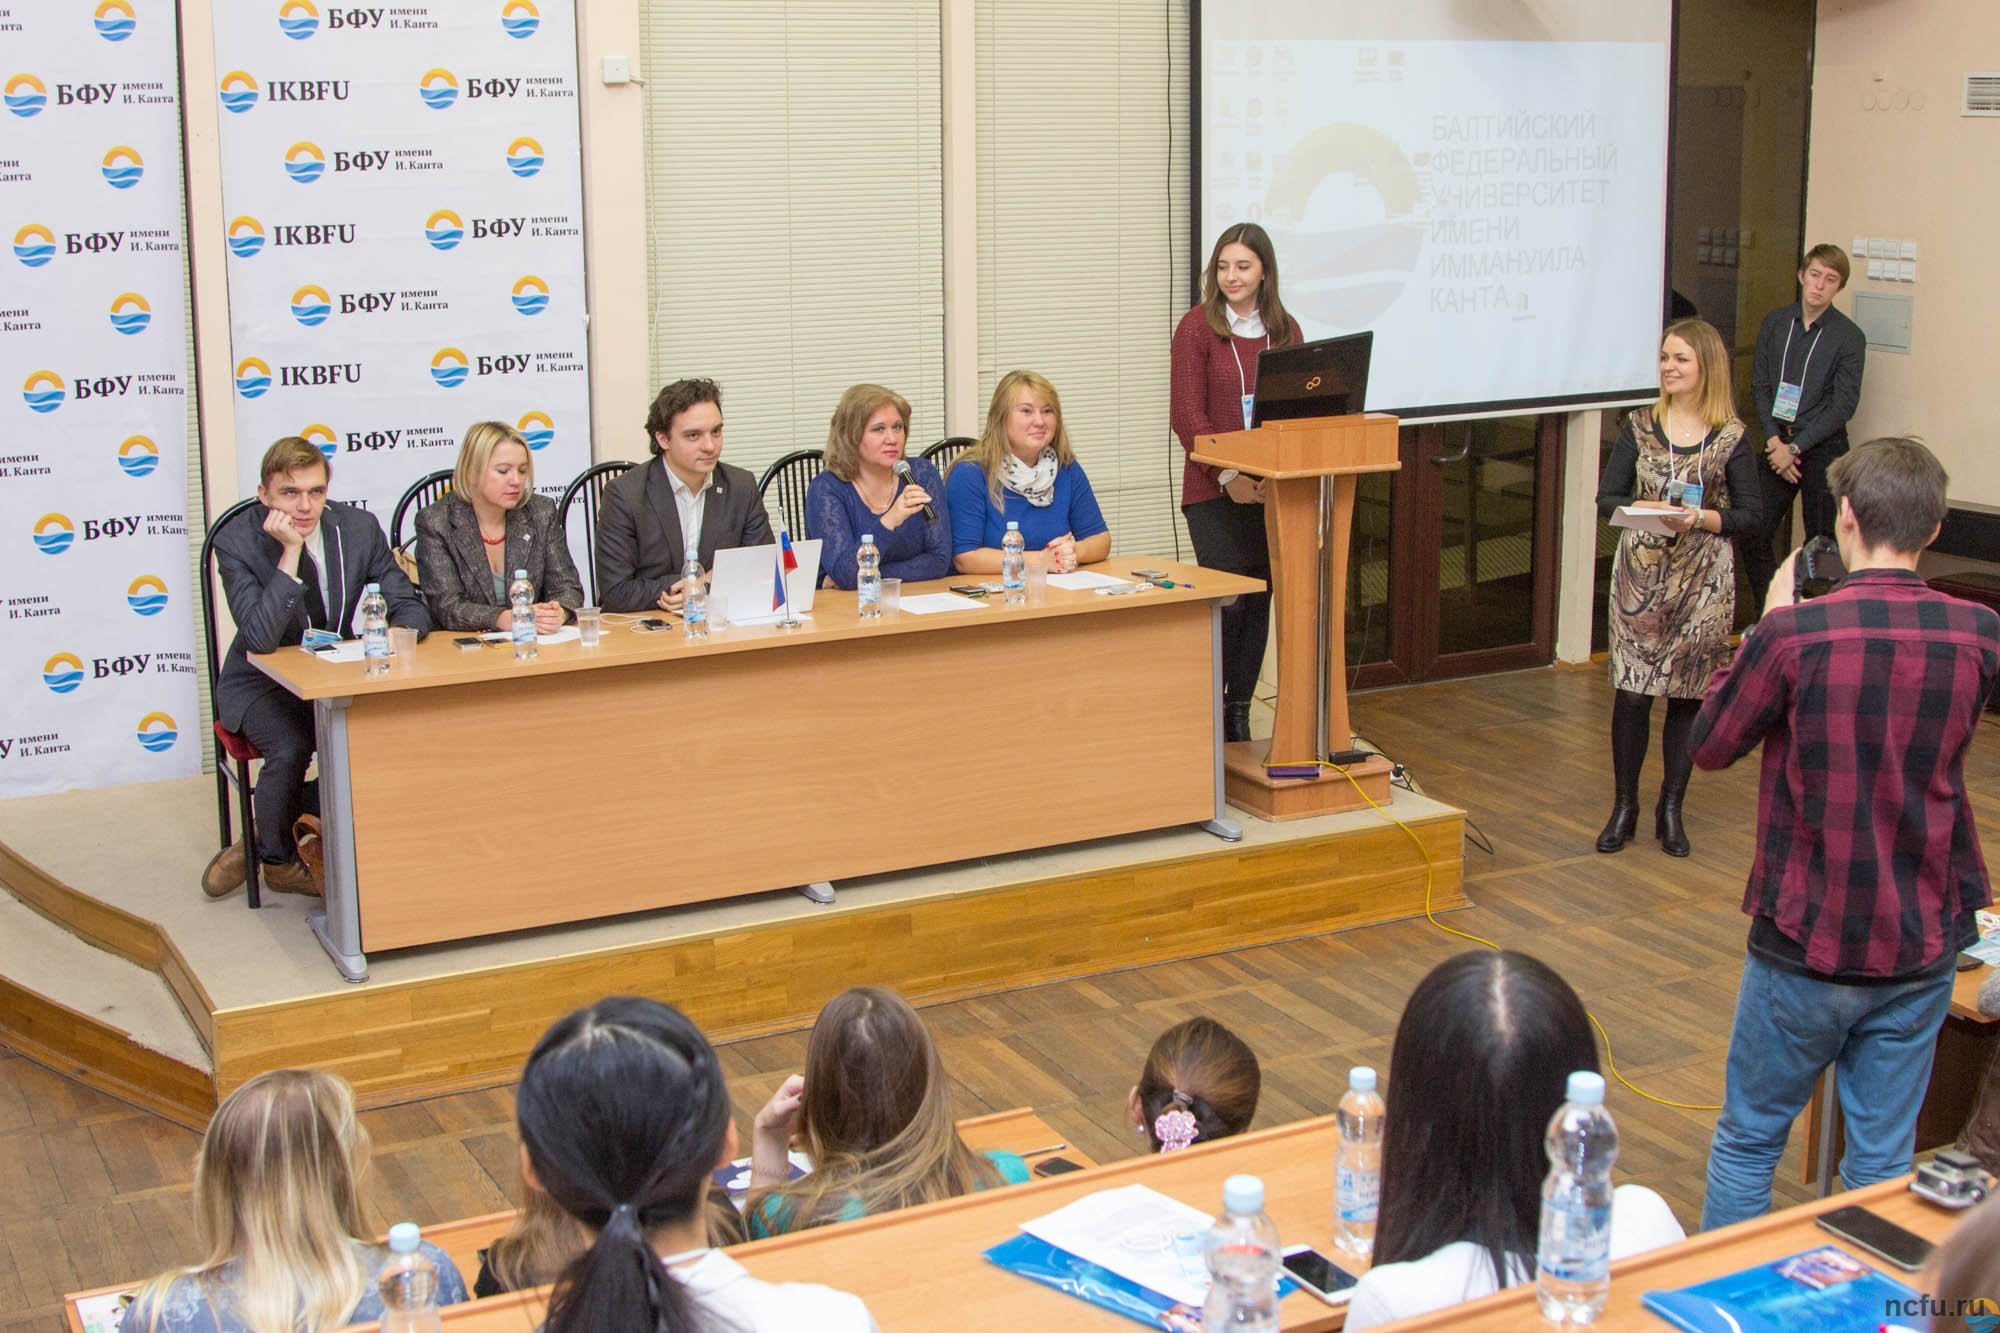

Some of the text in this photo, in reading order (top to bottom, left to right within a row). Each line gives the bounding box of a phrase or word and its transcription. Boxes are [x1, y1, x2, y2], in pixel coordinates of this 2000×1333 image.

[328, 9, 385, 29] БФУ
[390, 8, 428, 16] имени
[0, 22, 23, 31] нта
[122, 82, 163, 91] имени
[267, 81, 350, 101] IKBFU
[467, 78, 521, 98] БФУ
[526, 77, 563, 85] имени
[56, 84, 117, 105] БФУ
[1432, 106, 1596, 142] БАЛТИЙСКИЙ
[334, 150, 390, 172] БФУ
[395, 149, 433, 157] имени
[1432, 143, 1619, 180] ФЕДЕРАЛЬНЫЙ
[0, 172, 32, 182] анта
[1431, 179, 1610, 209] УНИВЕРСИТЕТ
[472, 218, 526, 239] БФУ
[531, 215, 568, 224] имени
[130, 229, 170, 238] имени
[273, 224, 356, 246] IKBFU
[1431, 216, 1520, 245] ИМЕНИ
[65, 232, 124, 254] БФУ
[1430, 241, 1587, 280] ИММАНУИЛА
[339, 292, 396, 314] БФУ
[401, 289, 438, 298] имени
[1430, 283, 1510, 313] КАНТА
[0, 309, 29, 318] мени
[477, 353, 531, 376] БФУ
[536, 351, 573, 360] имени
[138, 372, 176, 382] имени
[280, 363, 362, 387] IKBFU
[74, 376, 132, 400] БФУ
[345, 430, 402, 452] БФУ
[406, 426, 443, 436] имени
[83, 516, 141, 540] БФУ
[147, 514, 183, 522] имени
[8, 595, 49, 606] имени
[156, 652, 192, 660] имени
[93, 654, 151, 679] БФУ
[19, 733, 59, 744] имени
